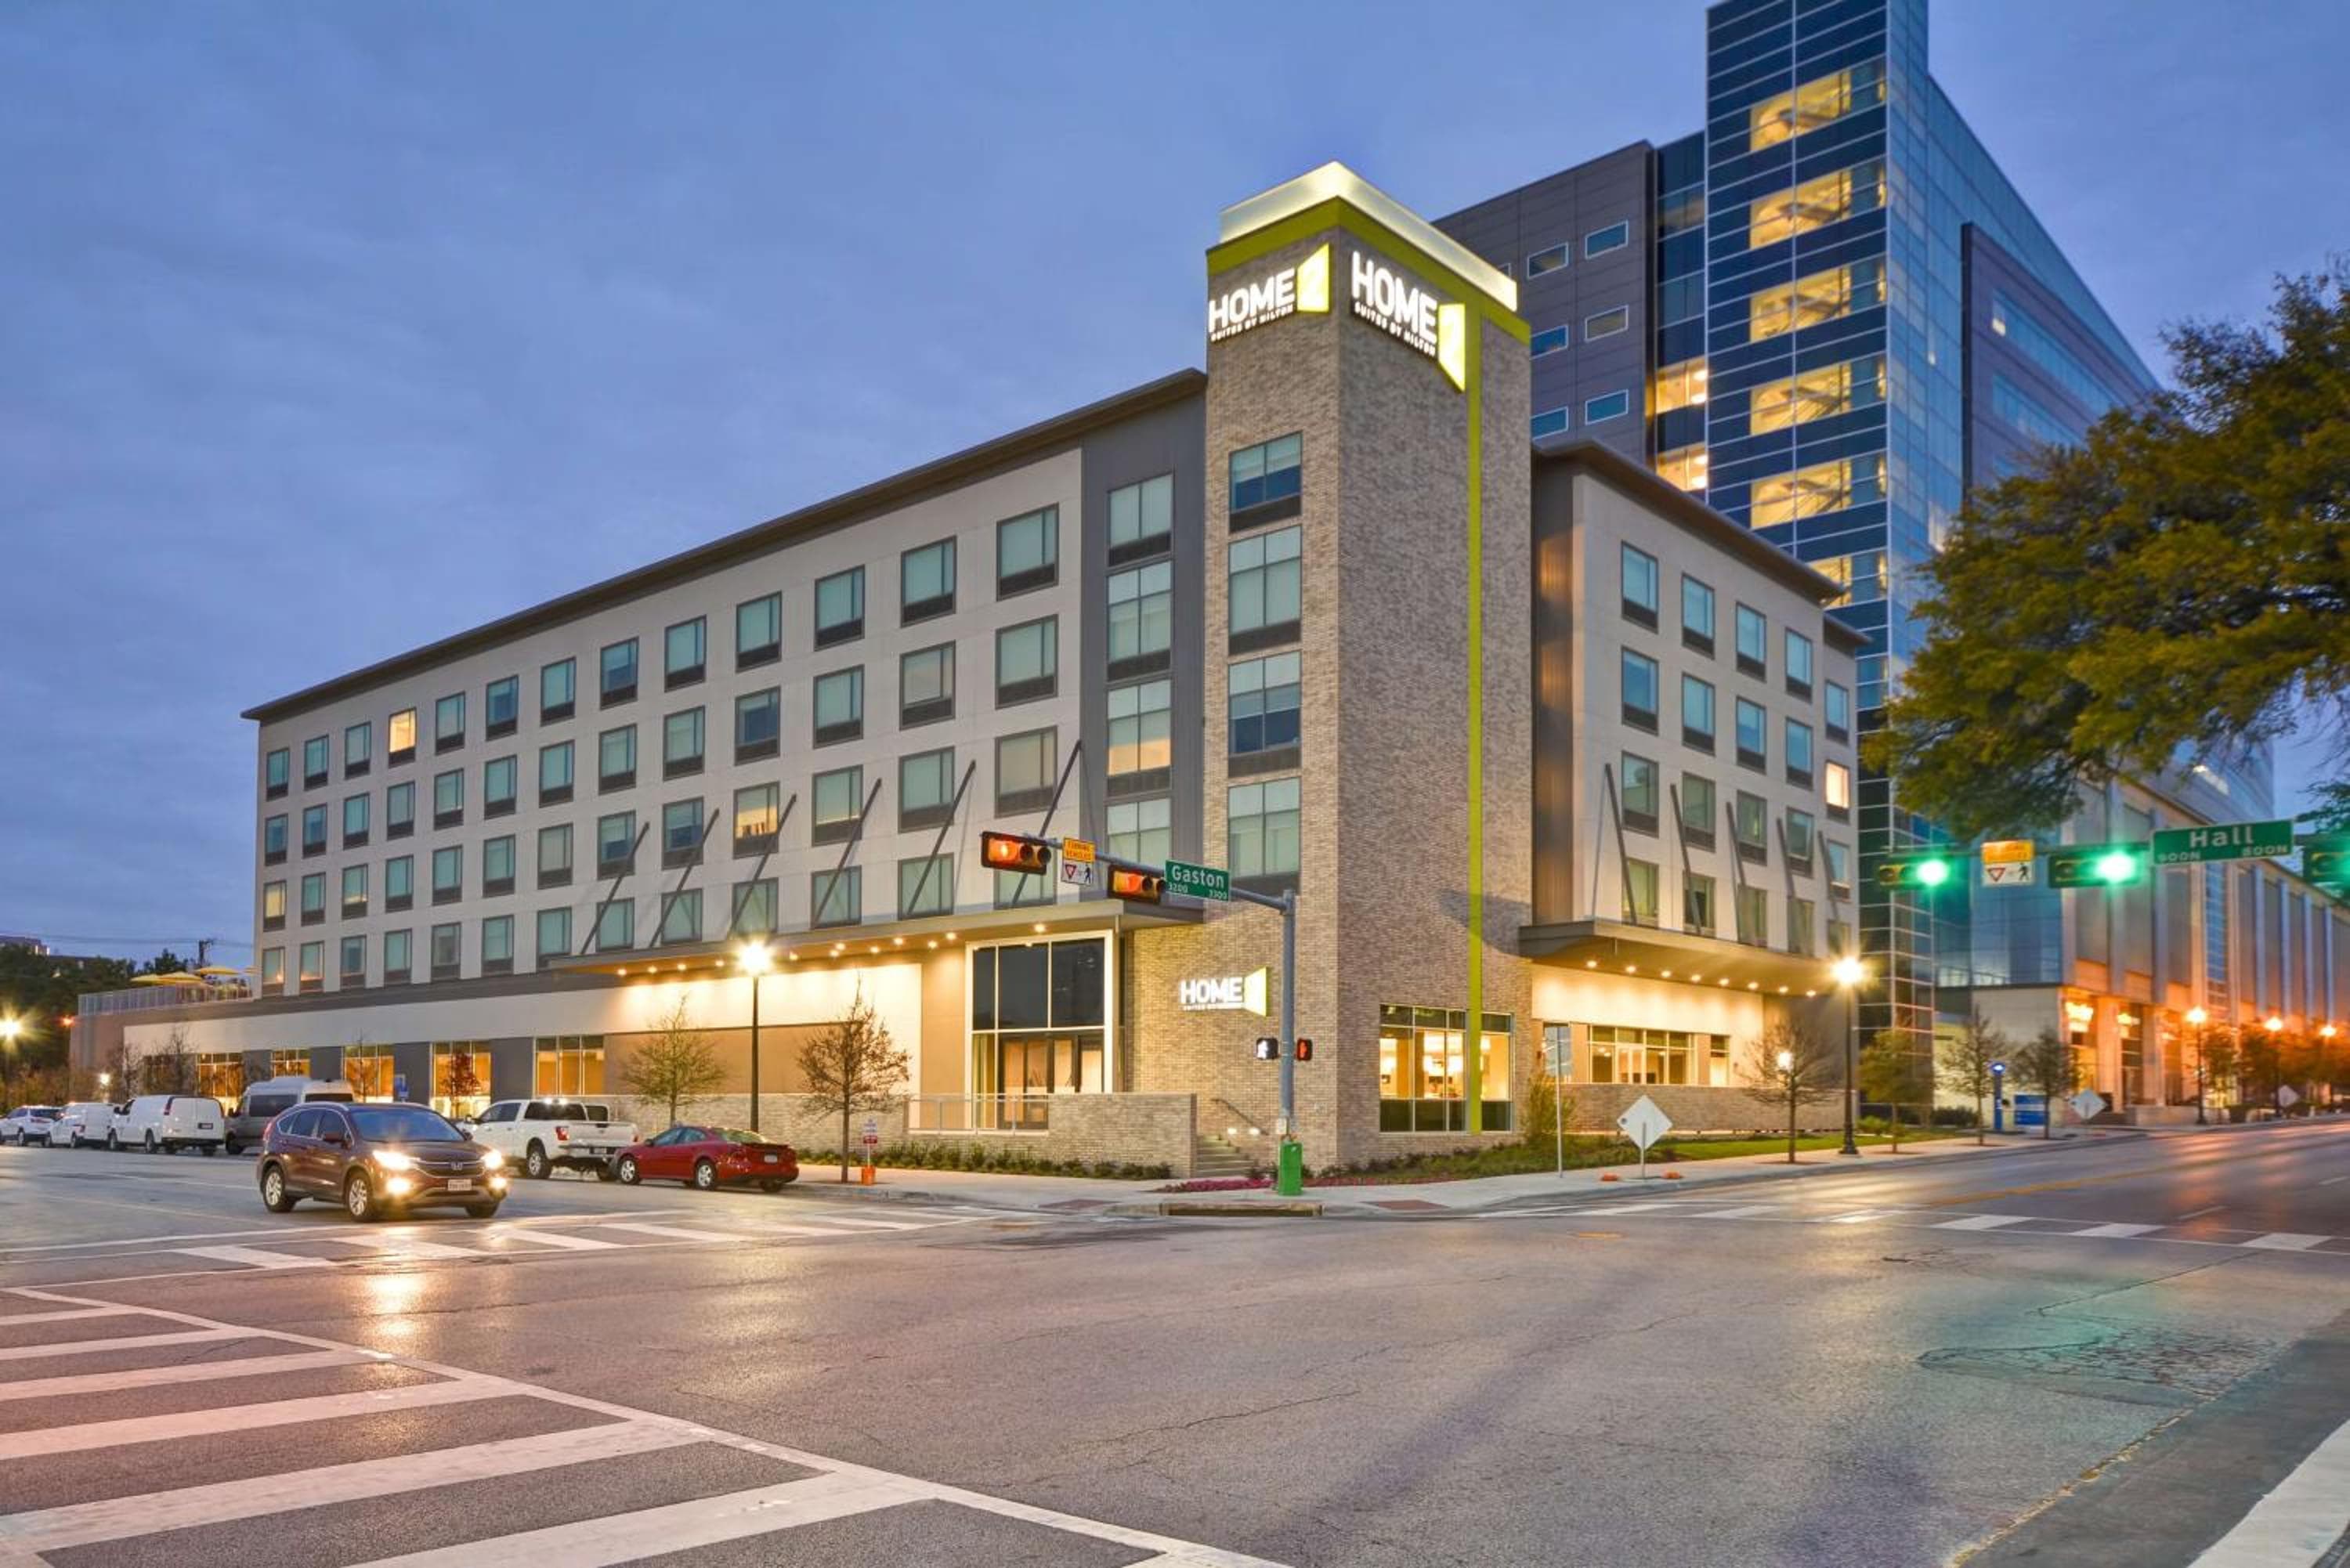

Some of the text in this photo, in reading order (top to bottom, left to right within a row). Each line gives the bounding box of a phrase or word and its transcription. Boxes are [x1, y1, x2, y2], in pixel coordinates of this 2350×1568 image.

[1209, 267, 1295, 333] HOME
[1351, 250, 1437, 345] HOME
[1210, 322, 1243, 341] SUITES
[1259, 303, 1294, 323] HILTON
[1354, 301, 1436, 357] SUITES BY HILTON
[2189, 826, 2254, 848] Hall
[1172, 865, 1224, 890] Gaston
[1180, 977, 1243, 1003] HOME
